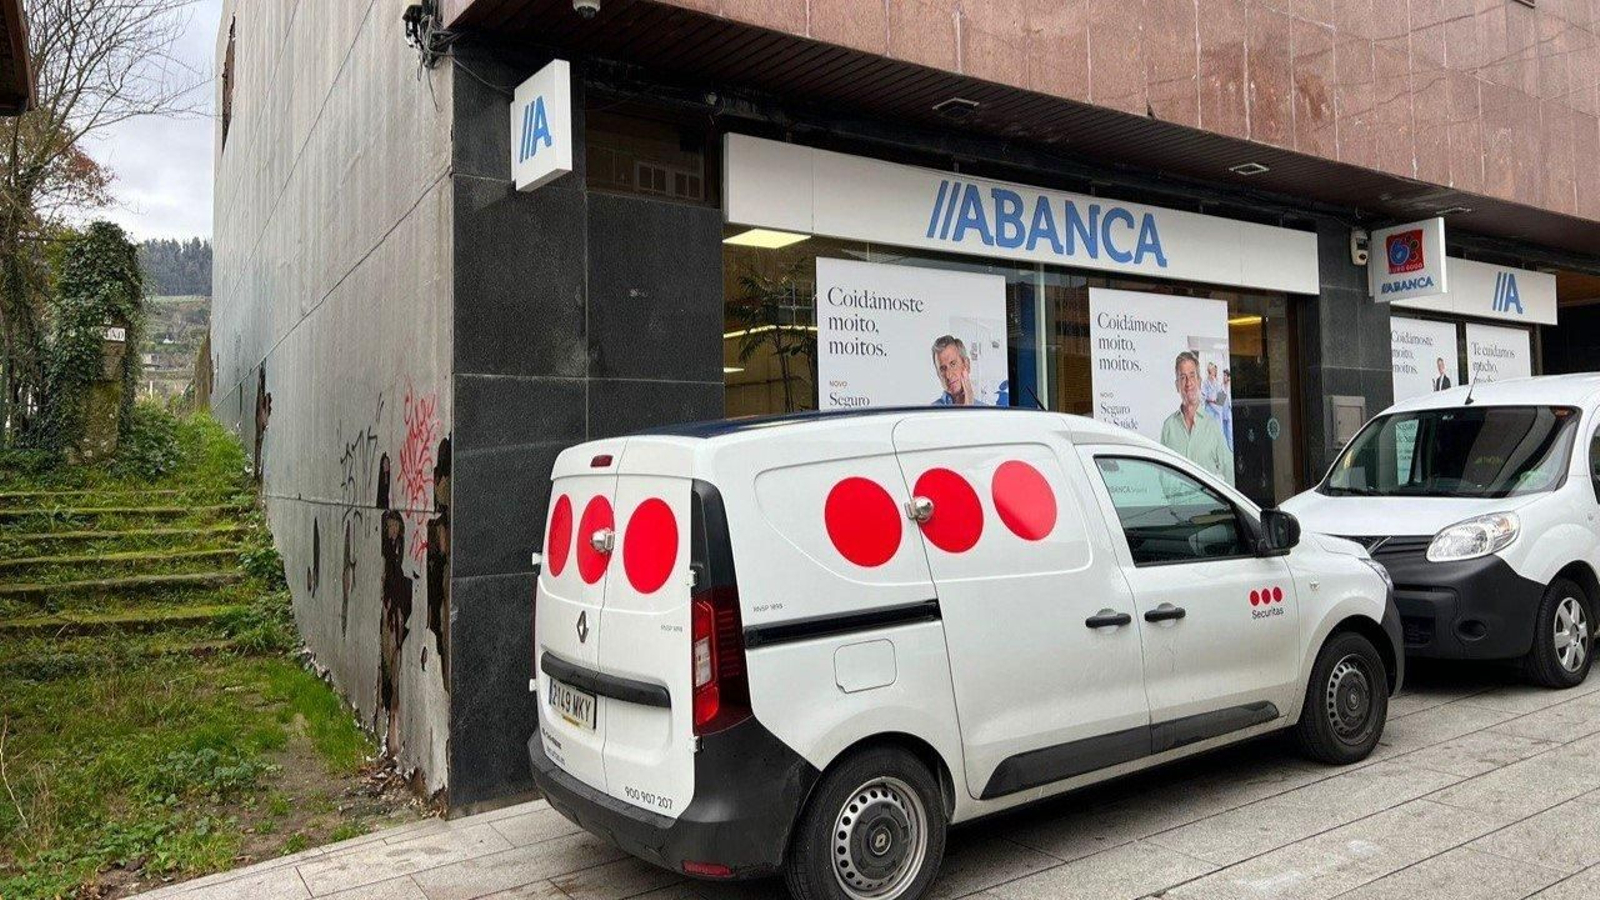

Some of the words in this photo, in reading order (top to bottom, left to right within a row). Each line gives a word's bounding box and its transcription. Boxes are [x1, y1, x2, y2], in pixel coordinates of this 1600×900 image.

[827, 286, 924, 313] Coidámoste
[828, 314, 880, 334] moito,
[1097, 312, 1168, 334] Coidámoste
[828, 337, 888, 357] moitos.
[1099, 355, 1142, 372] moitos.
[829, 391, 871, 408] Seguro
[1100, 402, 1131, 418] Seguro
[1251, 607, 1284, 620] Securitas
[625, 786, 640, 801] 900
[642, 791, 655, 805] 907
[656, 795, 673, 810] 207
